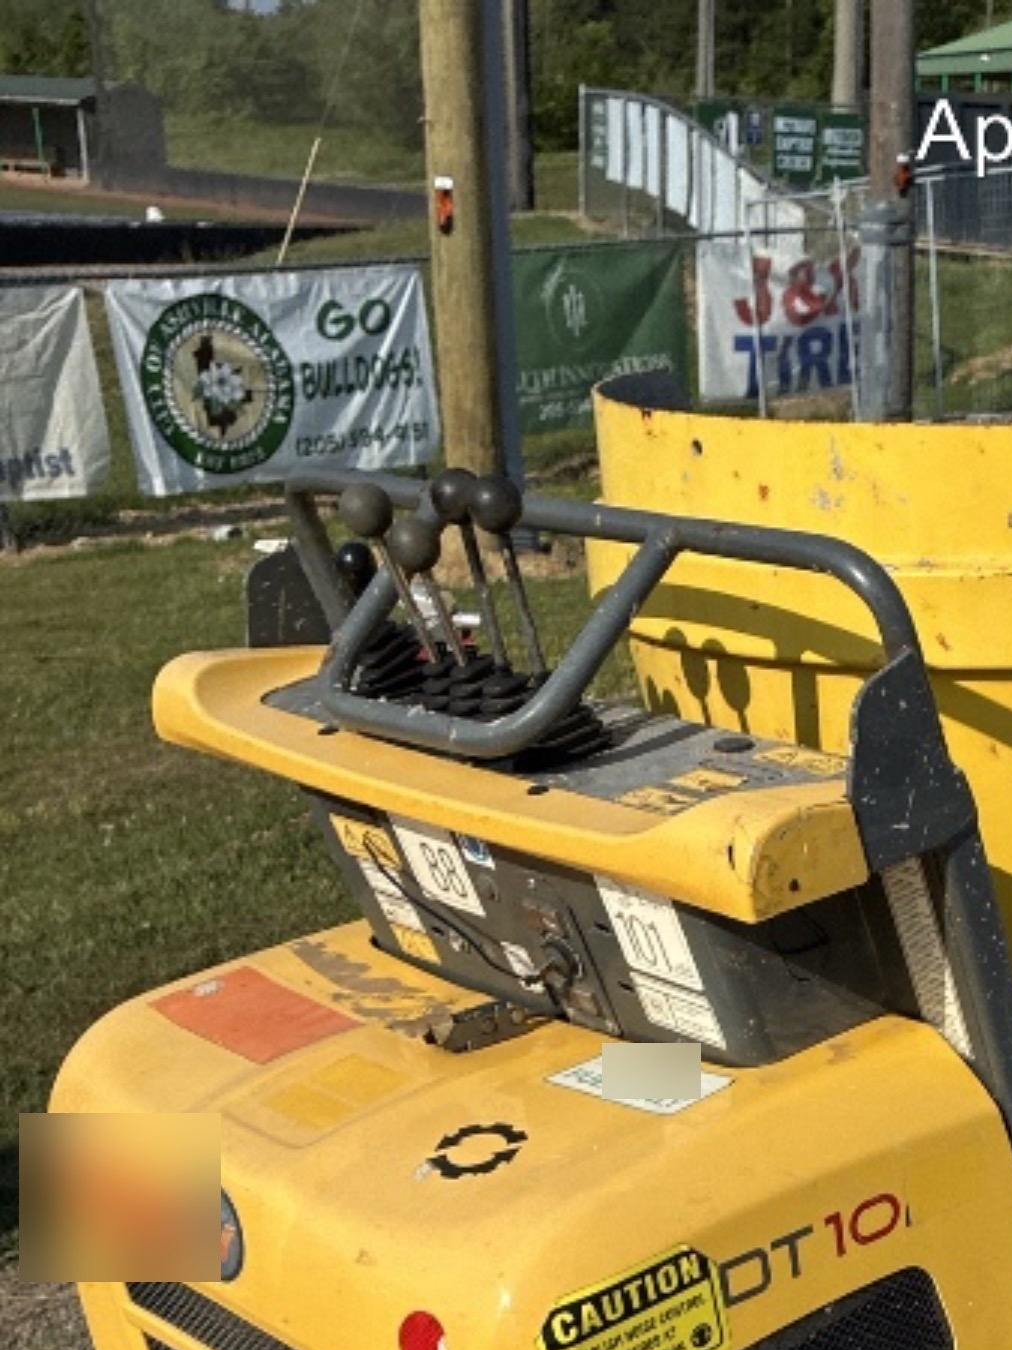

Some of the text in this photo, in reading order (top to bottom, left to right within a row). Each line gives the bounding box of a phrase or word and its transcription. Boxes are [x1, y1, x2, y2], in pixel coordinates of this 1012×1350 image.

[317, 299, 391, 340] GO
[301, 345, 423, 400] BULLDOGS!
[552, 1253, 701, 1346] CAUTION
